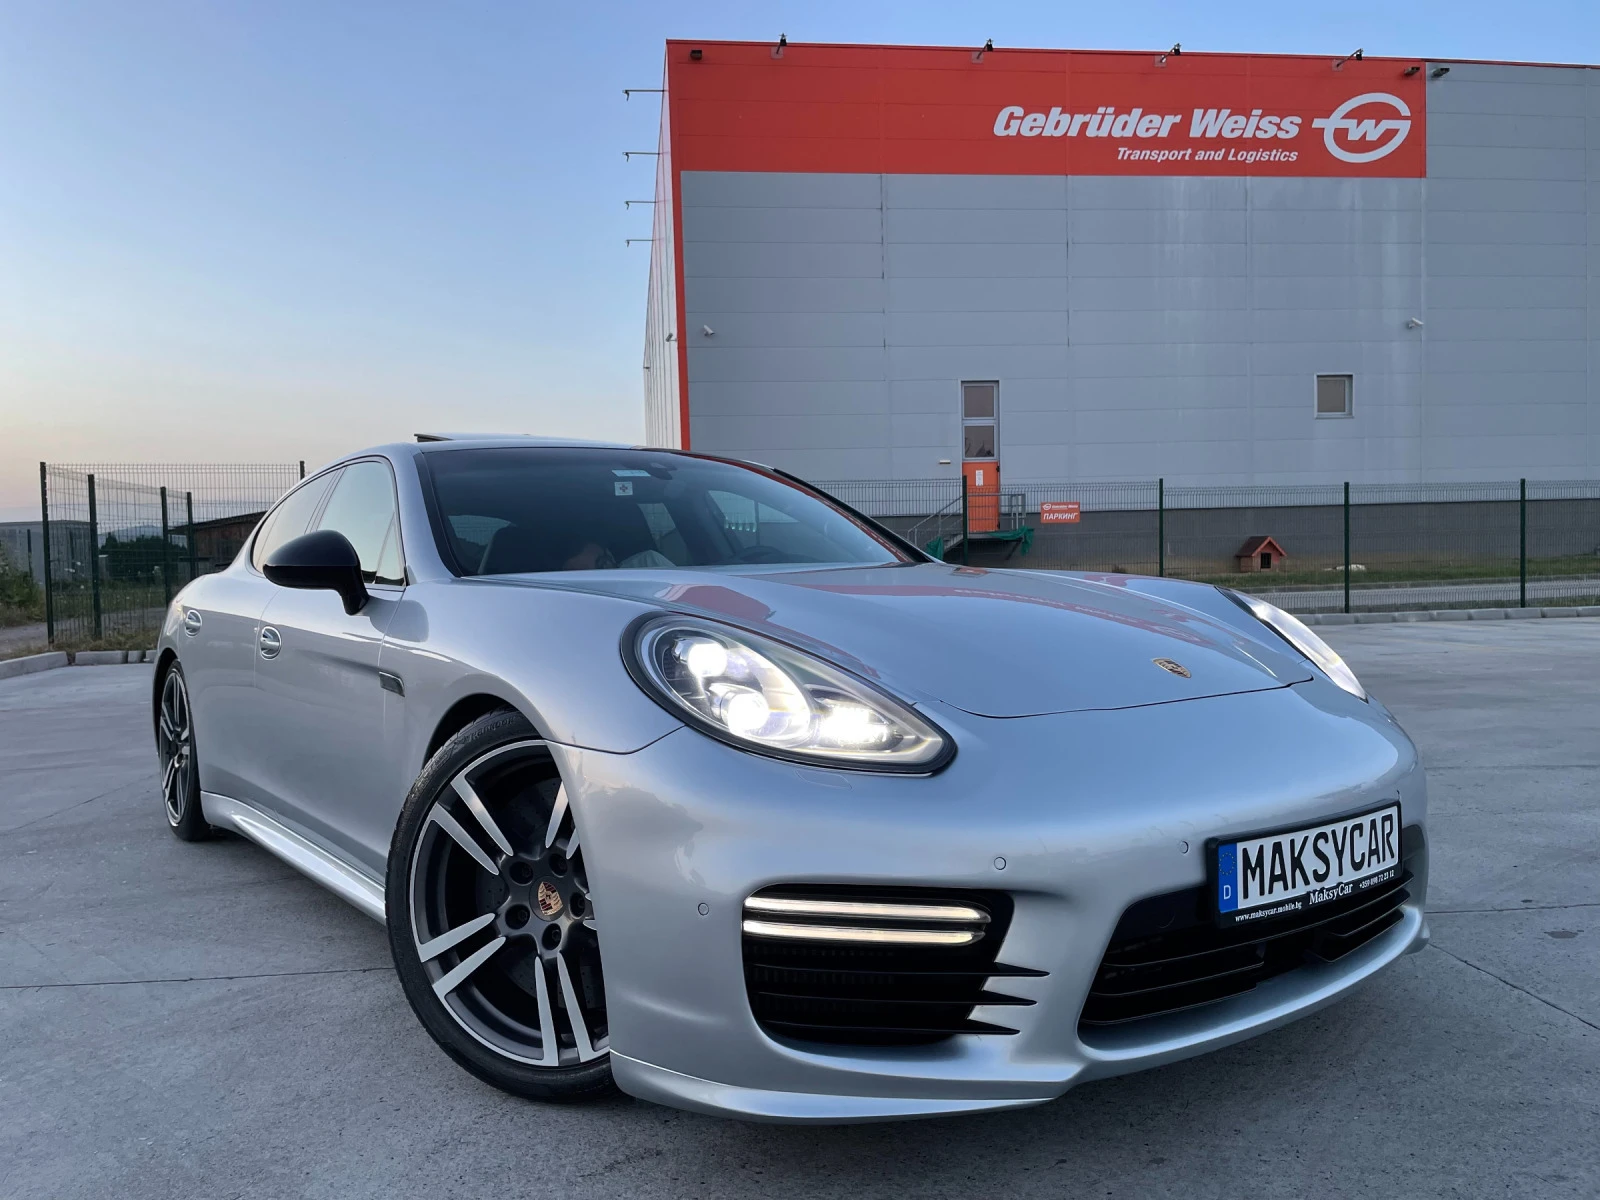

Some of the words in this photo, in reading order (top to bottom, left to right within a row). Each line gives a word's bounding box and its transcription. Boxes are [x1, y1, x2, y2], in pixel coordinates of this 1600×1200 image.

[993, 105, 1182, 138] Gebrüder
[1189, 108, 1302, 139] Weiss
[1117, 147, 1192, 163] Transport
[1195, 148, 1225, 162] and
[1228, 148, 1298, 163] Logistics
[1043, 512, 1079, 521] ПАРКИНГ
[1242, 813, 1395, 899] MAKSYCAR
[1223, 884, 1232, 900] D
[1309, 883, 1353, 905] MaksyCar
[1235, 901, 1303, 923] www.maksycar.mobile.bg
